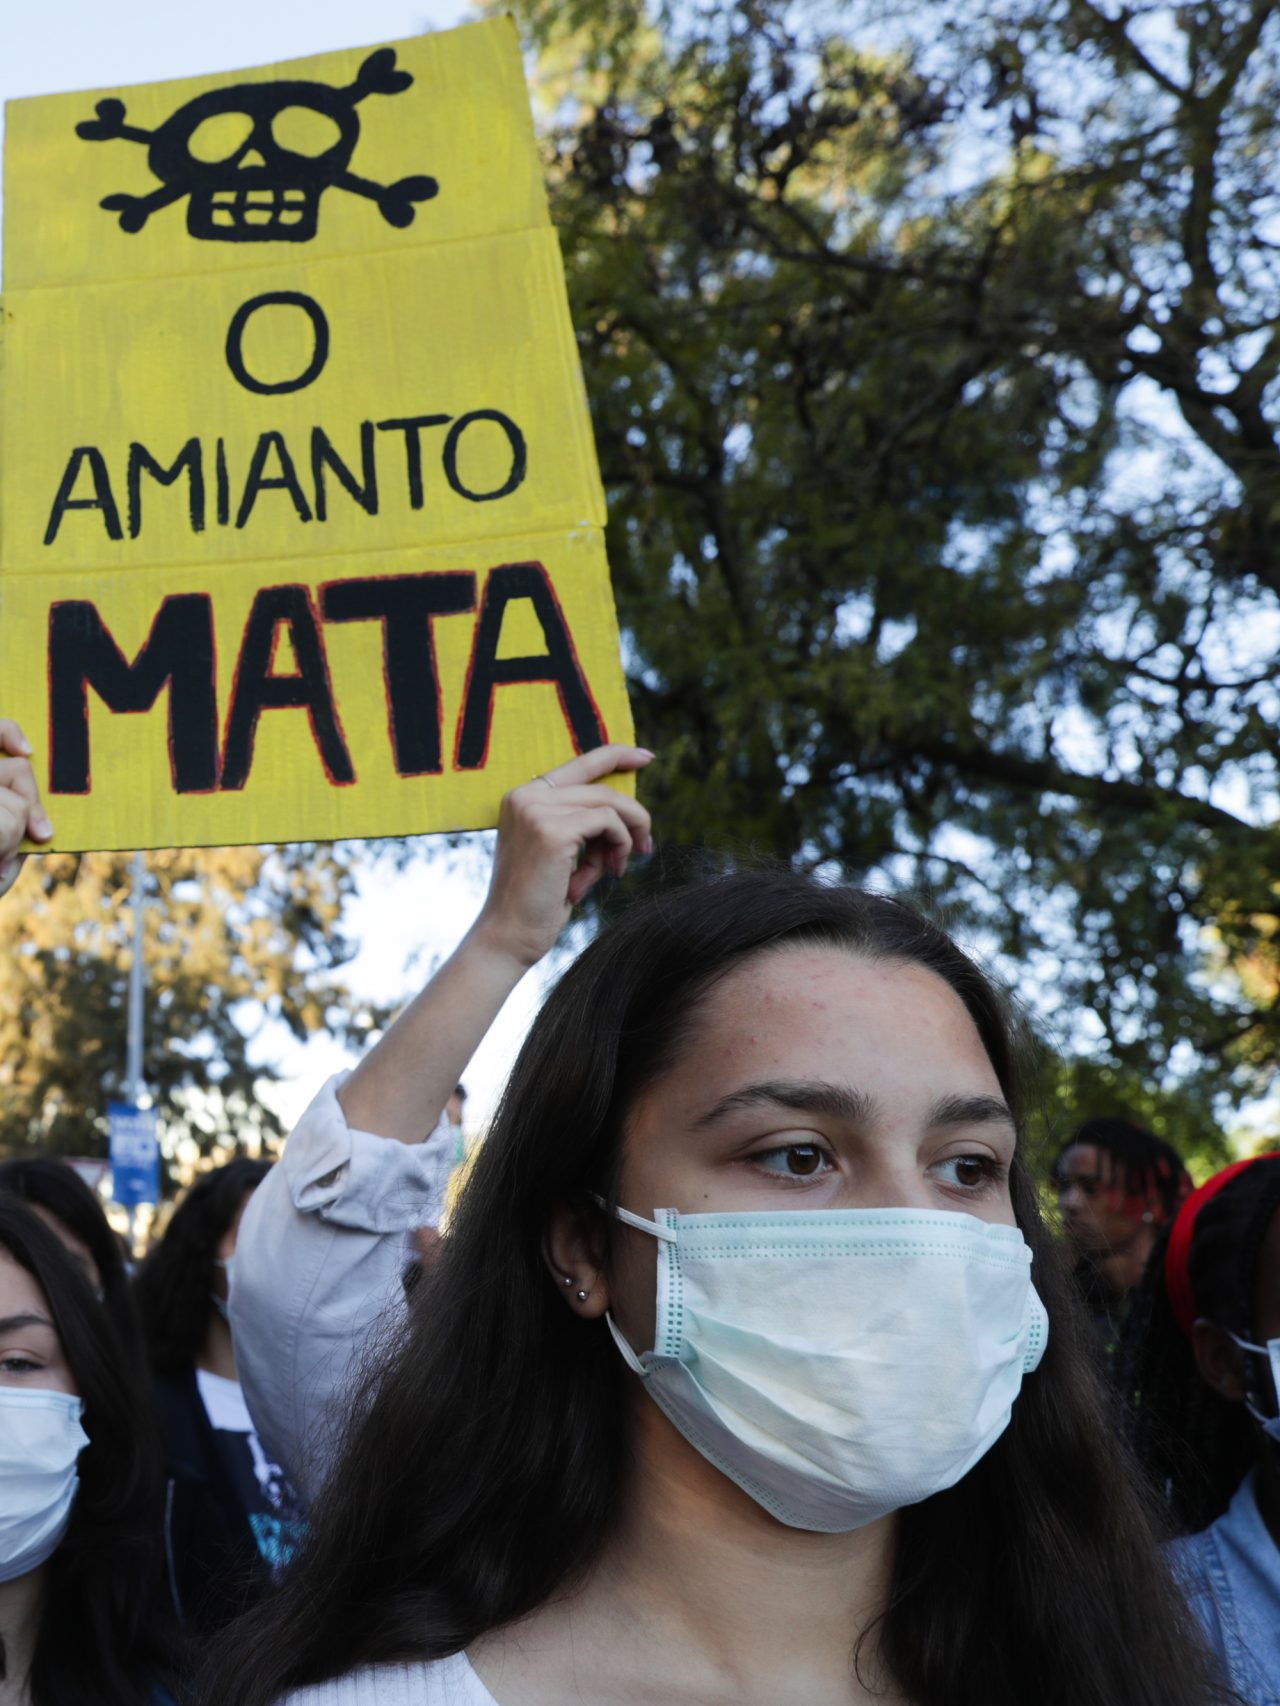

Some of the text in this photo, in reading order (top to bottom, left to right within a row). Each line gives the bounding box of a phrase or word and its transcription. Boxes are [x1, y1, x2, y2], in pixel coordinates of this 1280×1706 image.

[226, 291, 329, 395] O
[44, 410, 527, 545] AMIANTO
[48, 562, 609, 796] MATA
